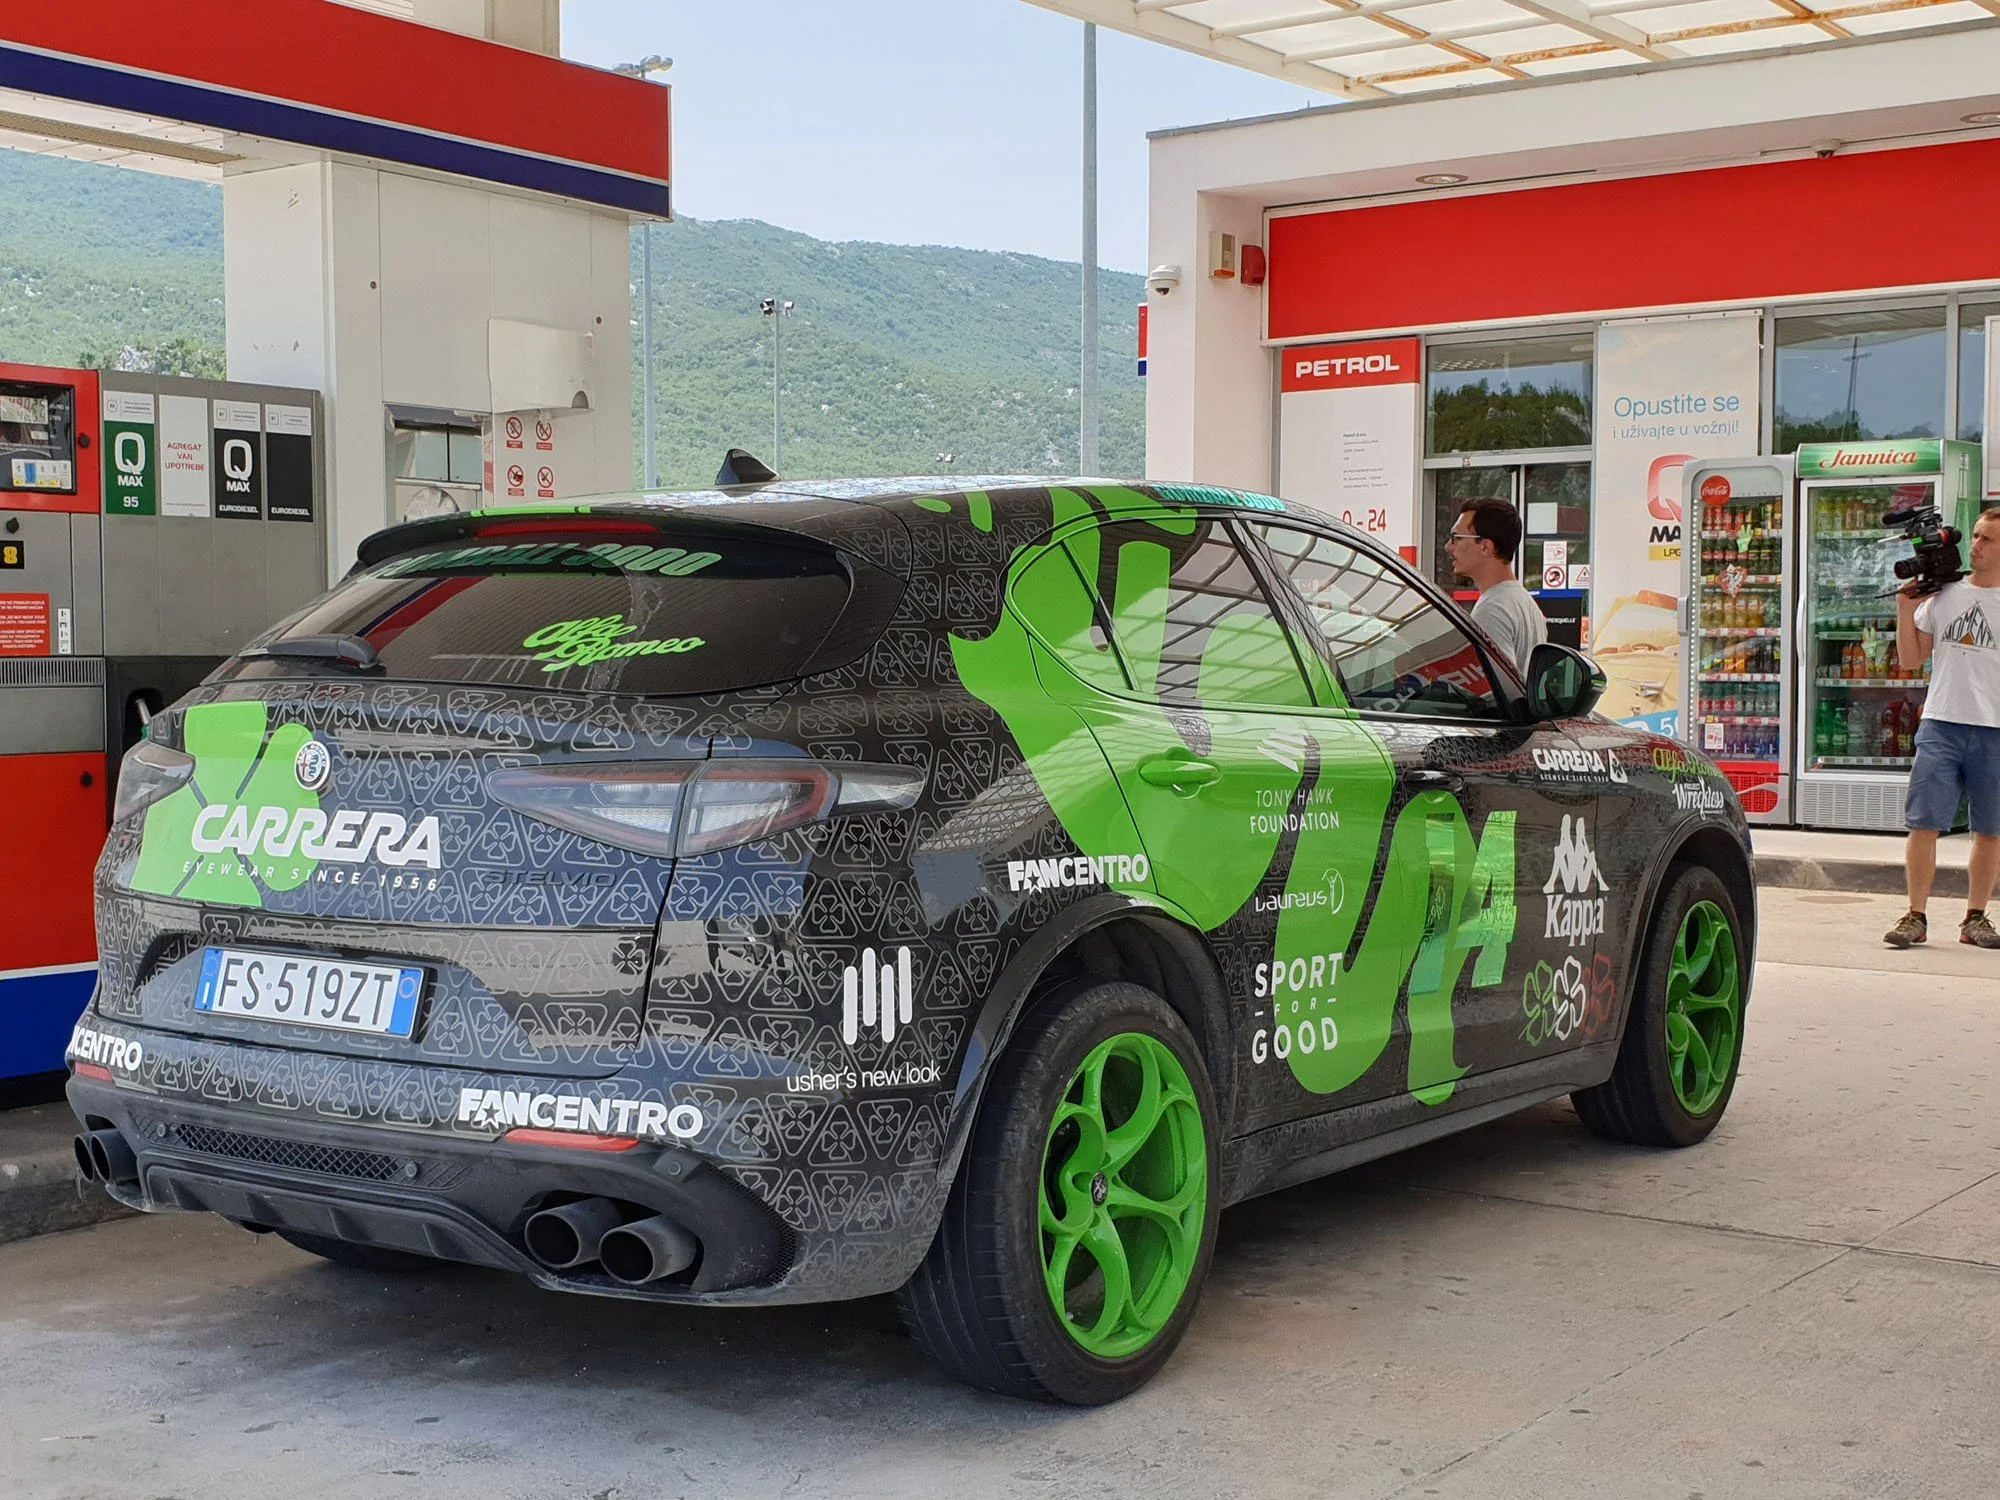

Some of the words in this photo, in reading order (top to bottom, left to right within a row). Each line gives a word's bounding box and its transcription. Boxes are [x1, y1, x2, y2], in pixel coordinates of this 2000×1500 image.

[1296, 355, 1400, 378] PETROL
[1614, 393, 1706, 421] Opustite
[1712, 395, 1740, 412] se
[1621, 423, 1675, 440] uživajte
[1679, 425, 1688, 436] u
[1693, 420, 1739, 437] vožnji!
[115, 431, 146, 475] Q
[167, 442, 202, 451] AGREGAT
[177, 452, 193, 461] VAN
[165, 462, 205, 471] UPOTREBE
[223, 439, 253, 481] Q
[1819, 449, 1918, 469] Jamnica
[117, 475, 144, 487] MAX
[226, 480, 251, 493] MAX
[123, 496, 139, 508] 95
[219, 504, 259, 513] EURODIESEL
[271, 507, 310, 516] EURODIESEL
[1368, 508, 1387, 531] 24
[1649, 525, 1681, 543] MA
[3, 546, 18, 564] 8
[561, 543, 723, 576] 3000
[523, 614, 638, 649] Alfa
[531, 637, 706, 672] Romeo
[1532, 748, 1606, 773] CARRERA
[1255, 789, 1292, 808] TONY
[1297, 787, 1335, 806] HAWK
[1250, 812, 1340, 834] FOUNDATION
[191, 804, 442, 869] CARRERA
[182, 861, 275, 879] EYEWEAR
[290, 867, 361, 885] SINCE
[379, 874, 438, 892] 1956
[482, 869, 618, 888] STELVIO
[1007, 853, 1150, 895] FANCENTRO
[1255, 890, 1328, 912] Laureus
[1543, 894, 1605, 947] Kappa
[1254, 952, 1343, 998] SPORT
[218, 957, 264, 1010] FS
[274, 962, 393, 1026] 519ZT
[1252, 1016, 1339, 1065] GOOD
[786, 1065, 857, 1092] usher's
[861, 1069, 902, 1088] new
[905, 1059, 941, 1085] look
[458, 1088, 704, 1138] FANCENTRO
